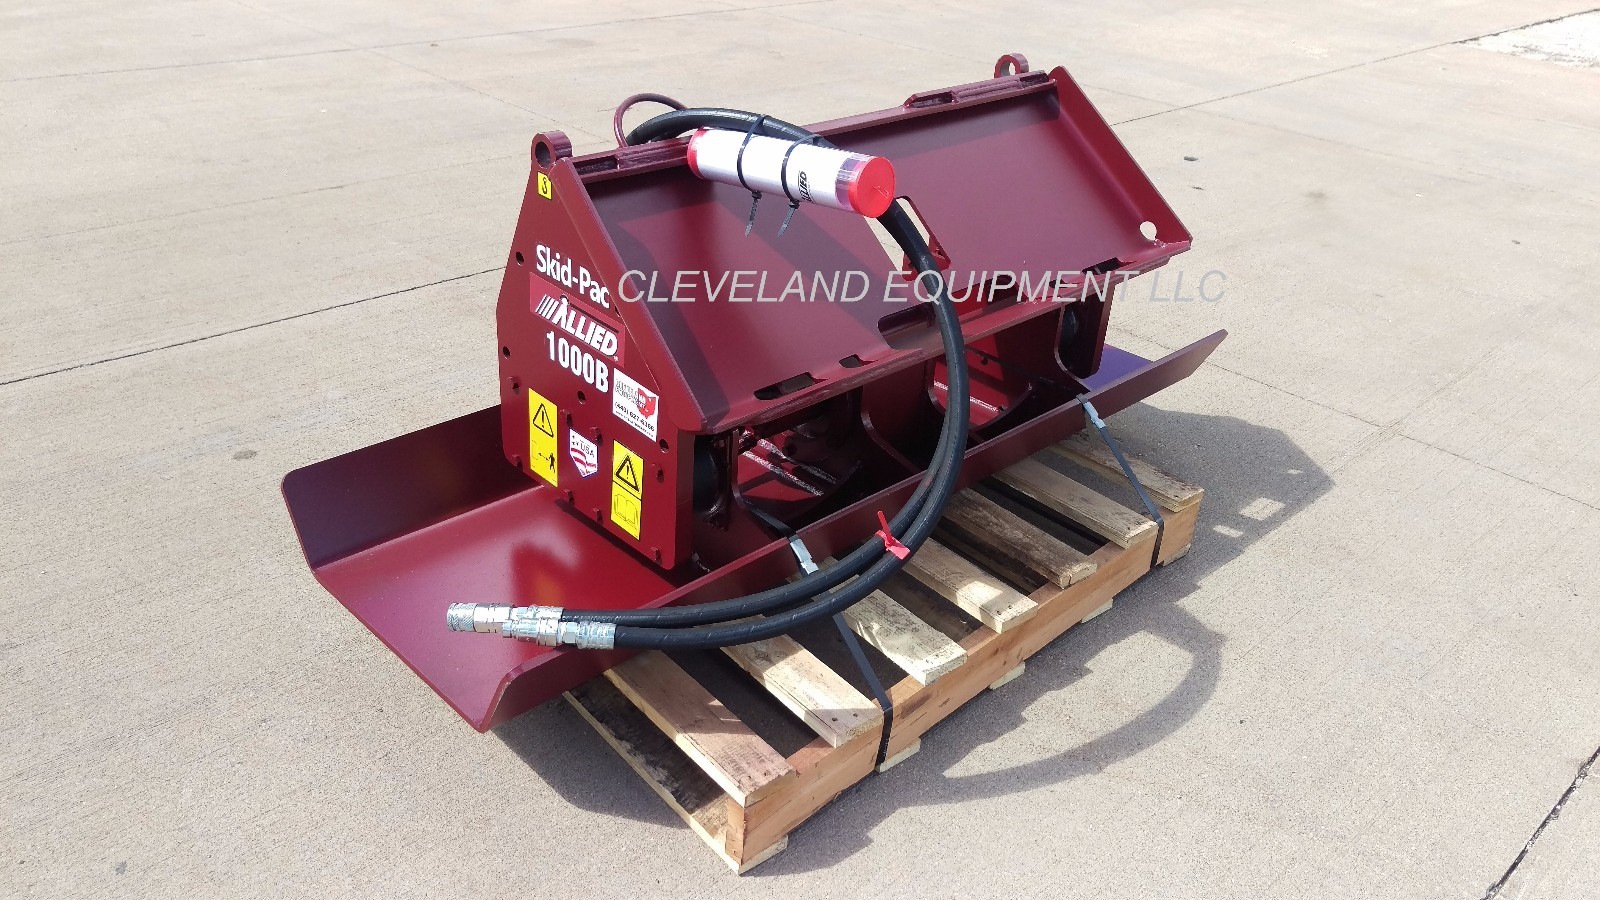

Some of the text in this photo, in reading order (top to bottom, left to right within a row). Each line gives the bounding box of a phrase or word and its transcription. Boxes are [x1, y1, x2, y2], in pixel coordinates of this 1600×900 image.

[536, 244, 610, 309] Skid-Pac
[551, 296, 618, 356] ALLIED
[546, 330, 609, 393] 1000B
[580, 442, 595, 458] USA
